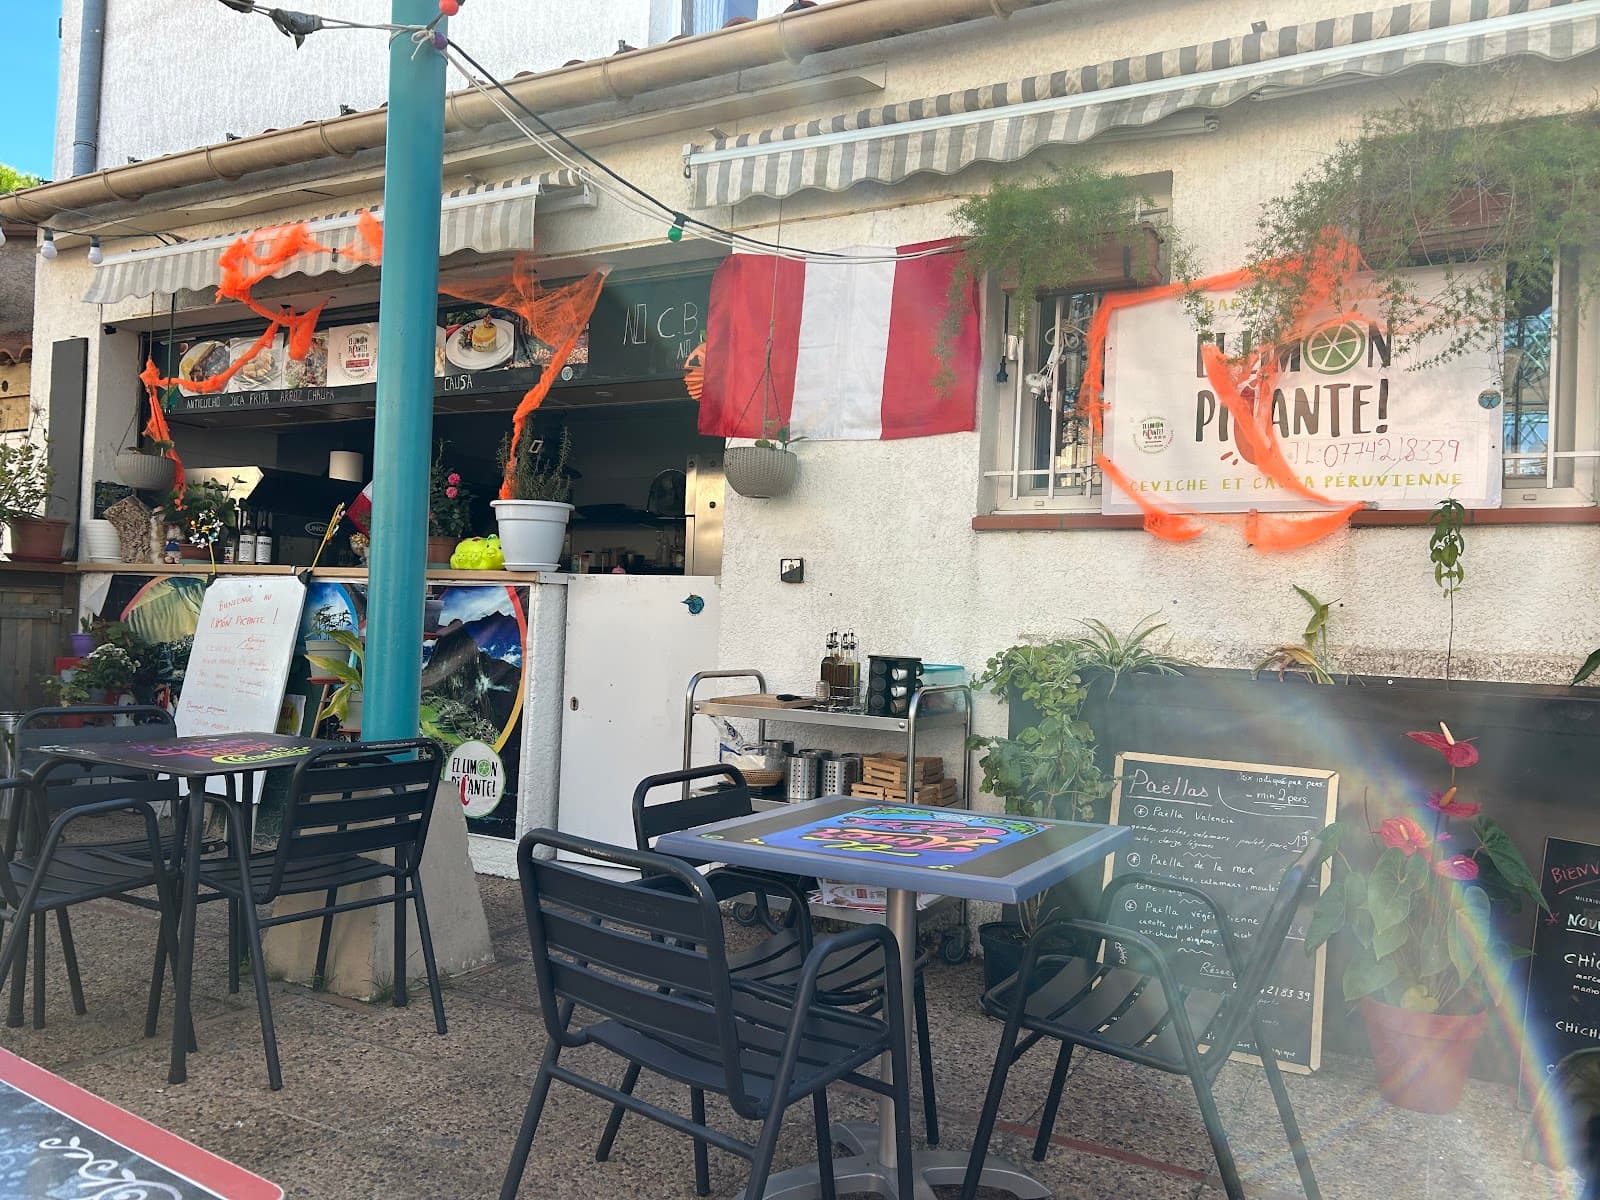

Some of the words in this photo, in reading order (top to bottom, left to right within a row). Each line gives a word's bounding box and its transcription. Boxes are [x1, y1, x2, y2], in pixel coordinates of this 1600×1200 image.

[444, 374, 473, 391] CAUSA
[1129, 478, 1208, 492] CEVICHE
[1222, 477, 1244, 490] ET
[1253, 475, 1314, 490] CAA
[1324, 472, 1464, 488] PÉRUVIENNE
[452, 758, 461, 773] EL
[462, 758, 498, 777] LIMON
